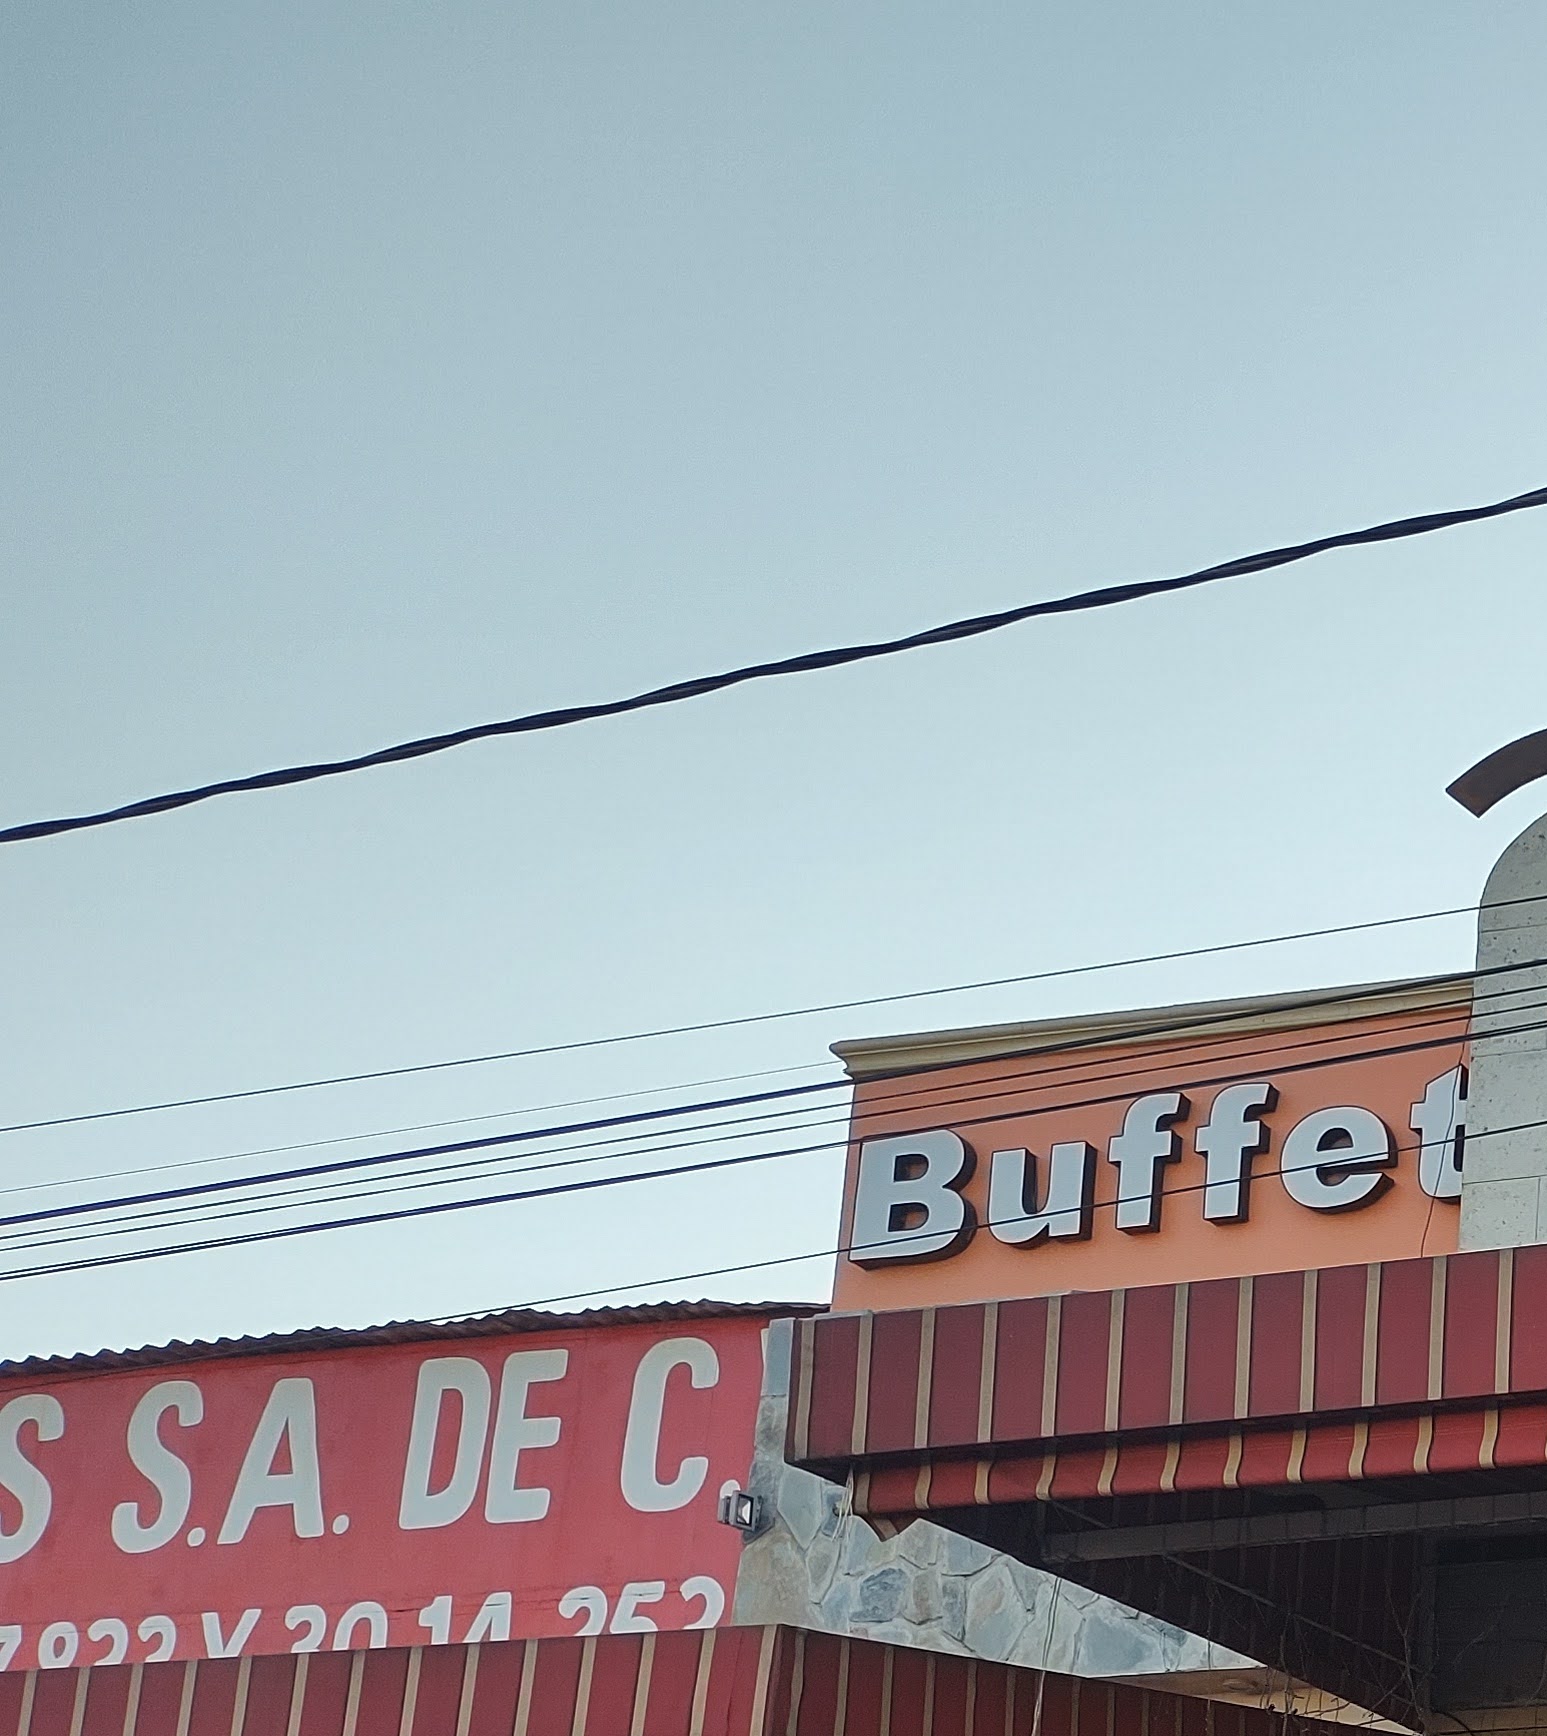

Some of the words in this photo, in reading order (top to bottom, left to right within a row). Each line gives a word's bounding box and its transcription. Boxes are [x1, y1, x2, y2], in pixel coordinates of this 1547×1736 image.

[847, 1063, 1468, 1268] Buffet
[110, 1377, 351, 1555] S.A.
[399, 1348, 570, 1530] DE
[620, 1327, 770, 1516] C.
